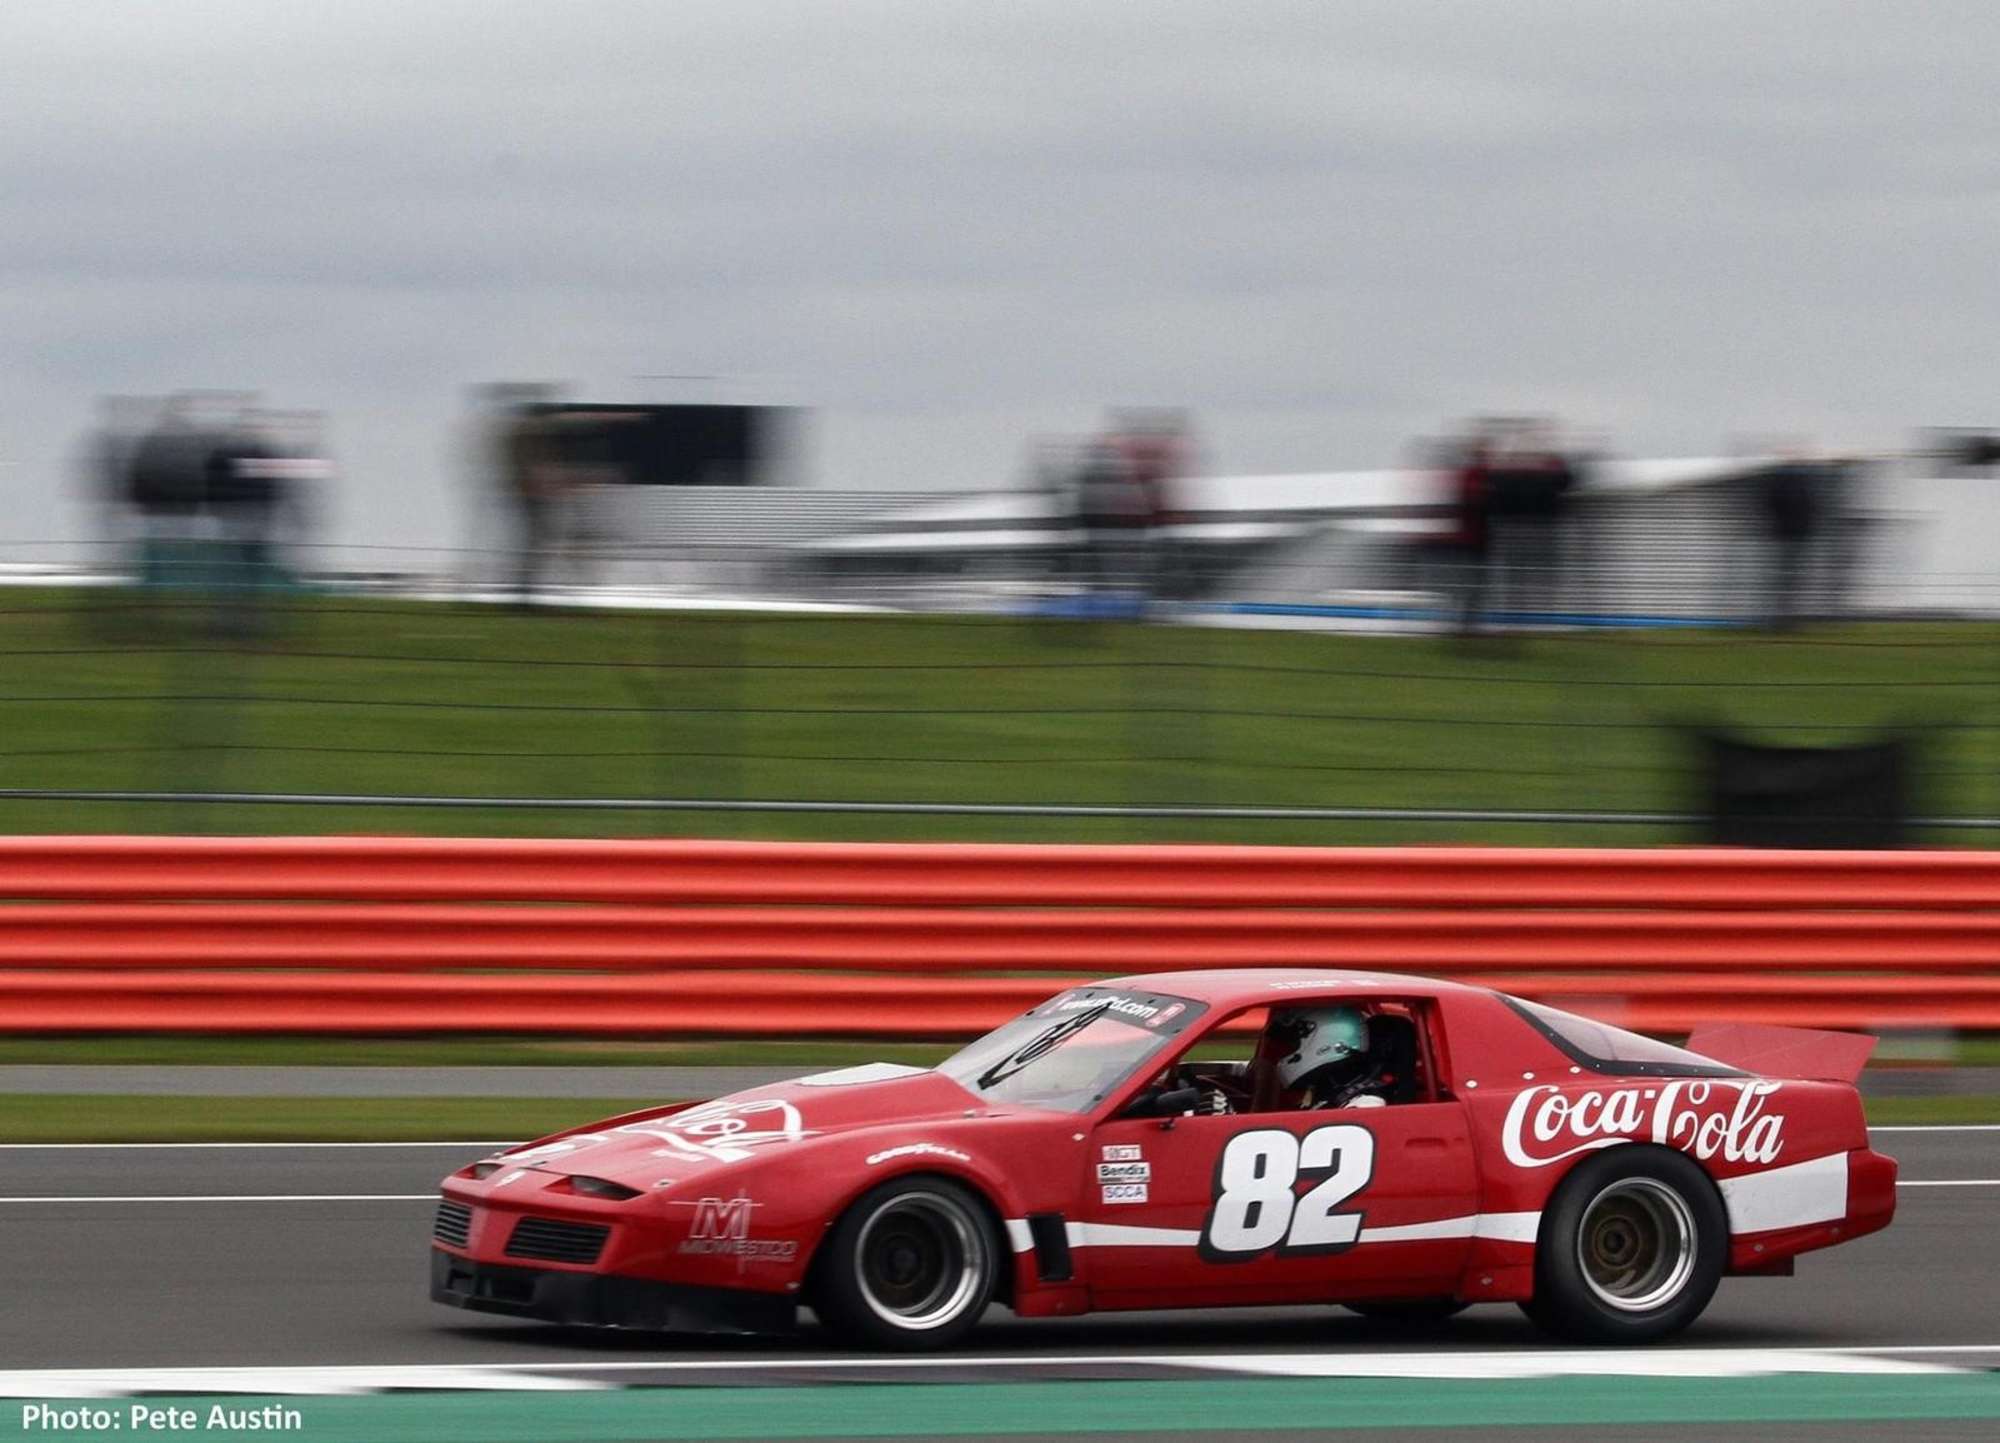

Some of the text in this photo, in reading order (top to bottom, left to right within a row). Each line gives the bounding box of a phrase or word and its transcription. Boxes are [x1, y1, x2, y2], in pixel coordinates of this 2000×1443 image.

[1502, 1081, 1785, 1168] Coca-Cola
[1100, 1164, 1146, 1177] Bendix
[1104, 1186, 1143, 1198] SCCA
[1208, 1124, 1375, 1253] 82
